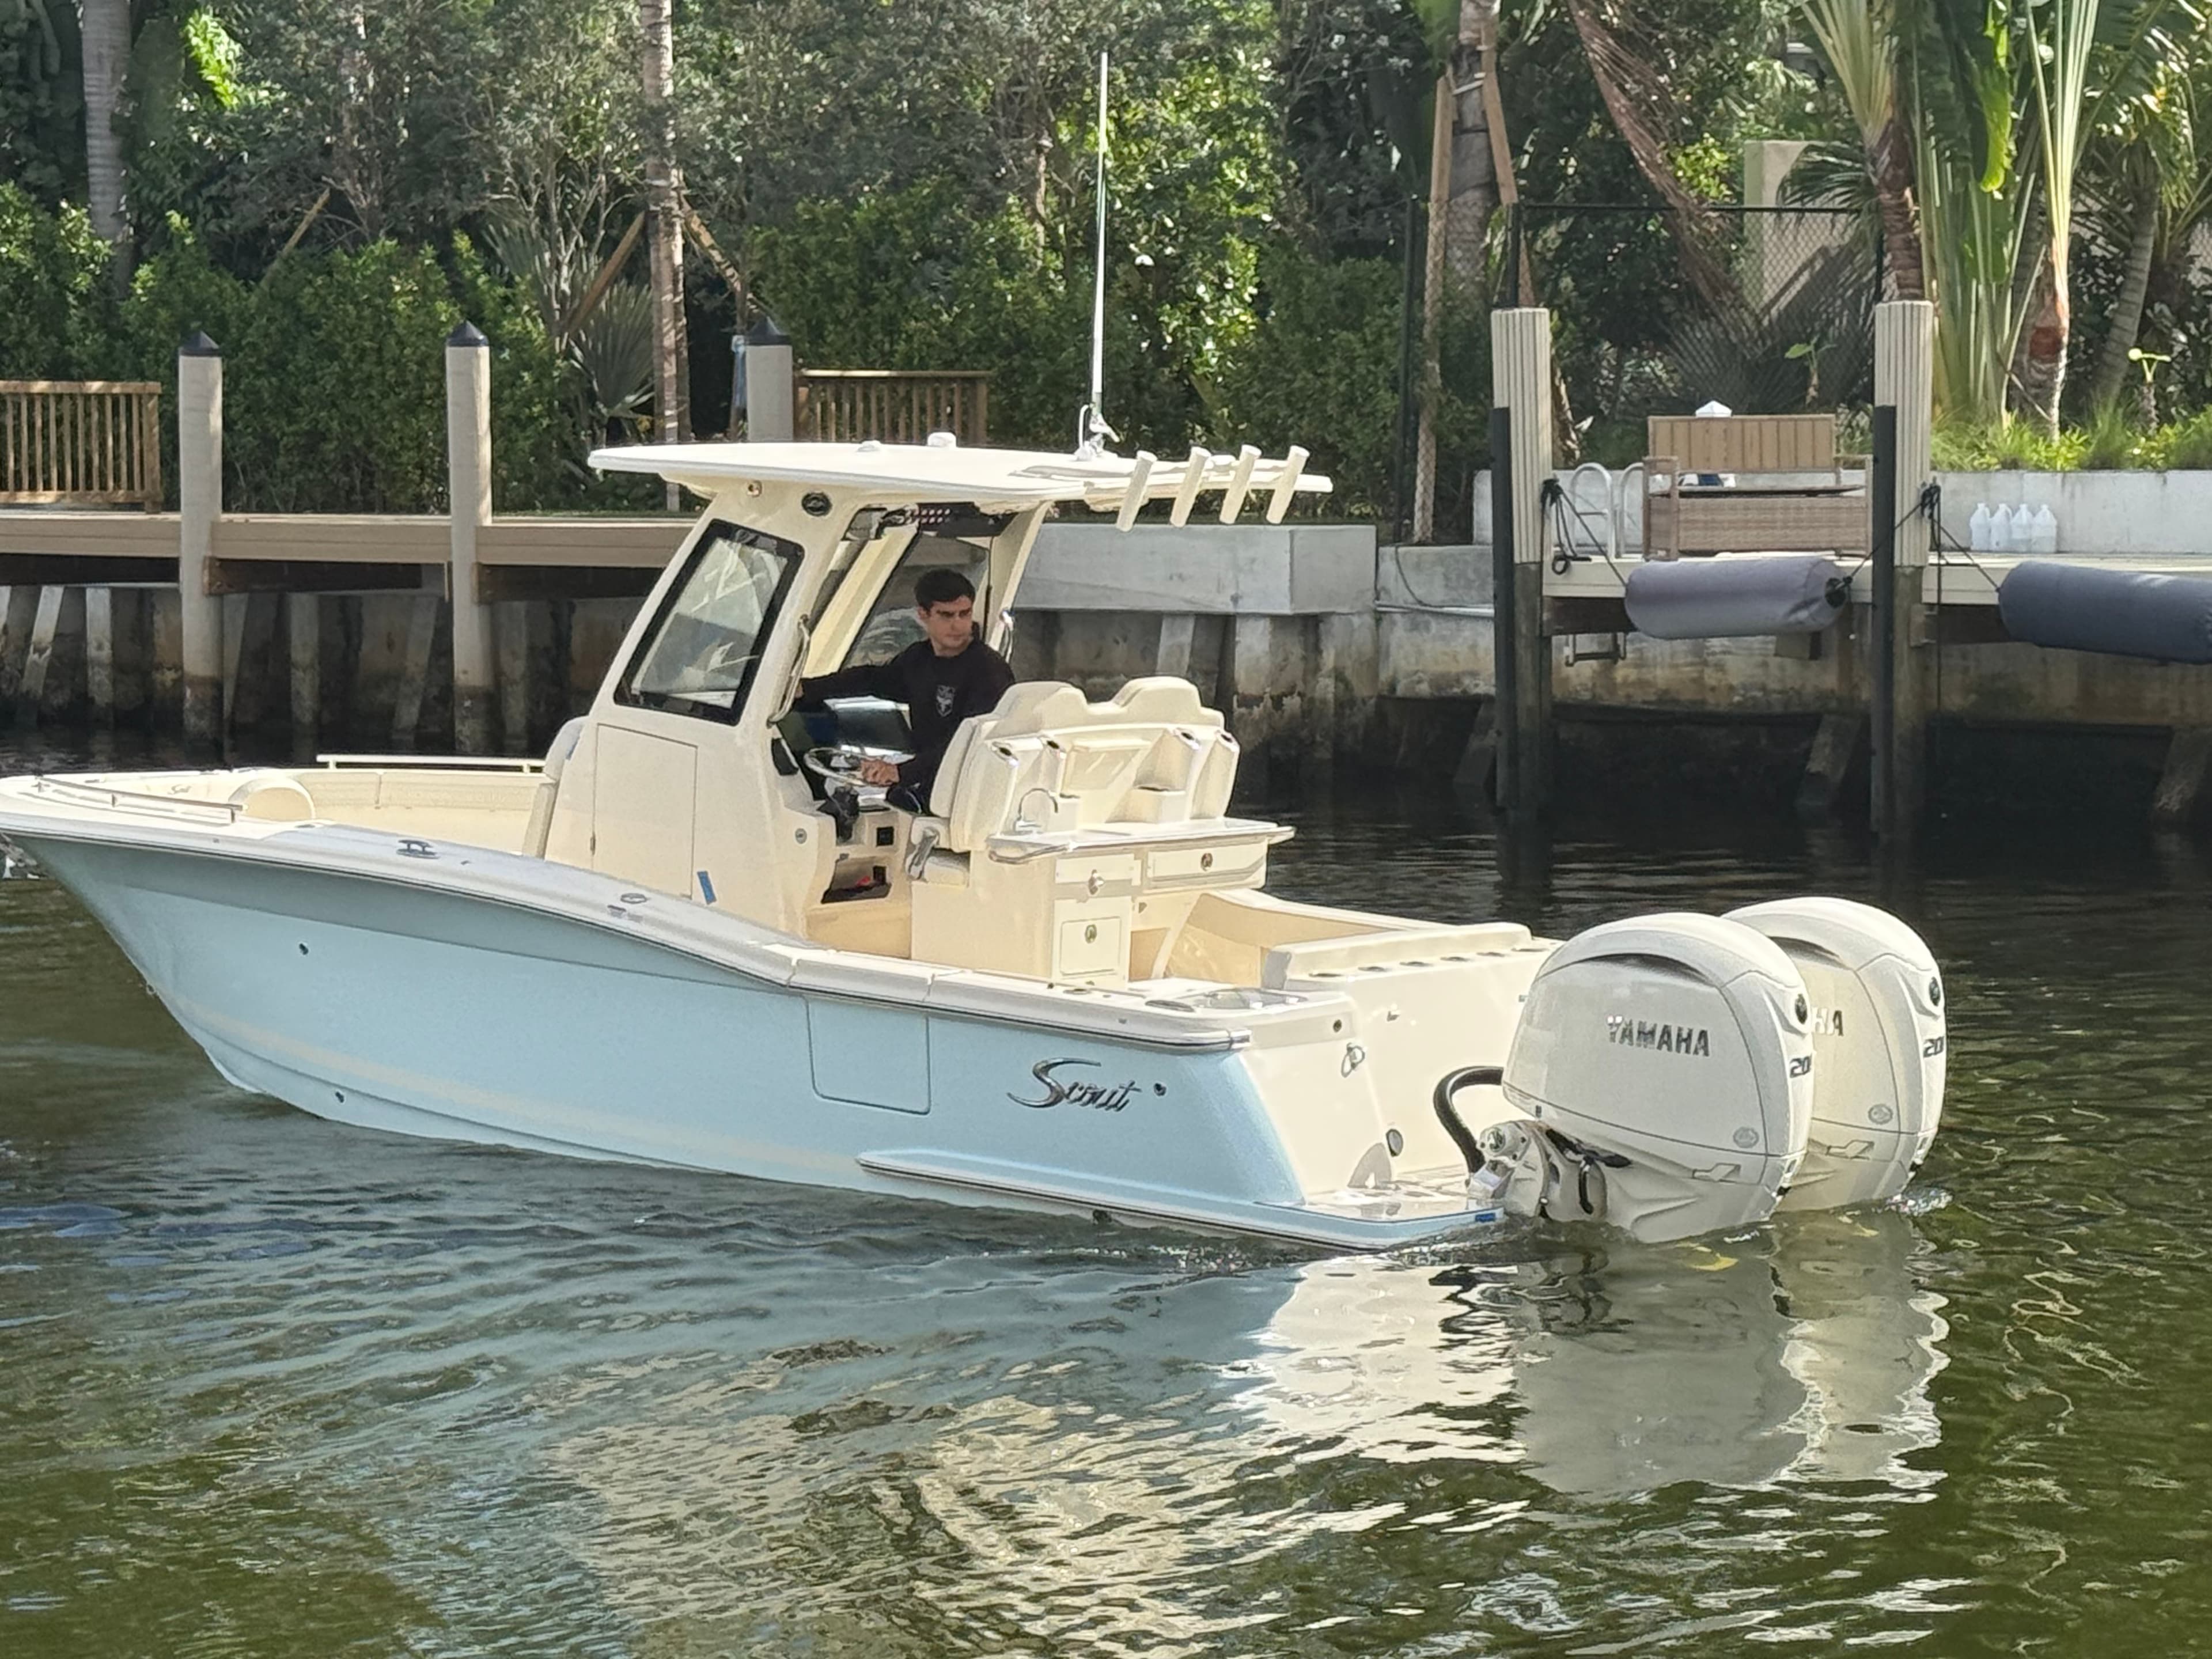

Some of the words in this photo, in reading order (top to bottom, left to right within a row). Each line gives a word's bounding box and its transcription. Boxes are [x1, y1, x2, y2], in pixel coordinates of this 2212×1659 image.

[1607, 1016, 1709, 1057] YAMAHA
[1923, 1036, 1944, 1058] 20
[1790, 1054, 1812, 1078] 20
[1006, 1057, 1142, 1112] Scout
